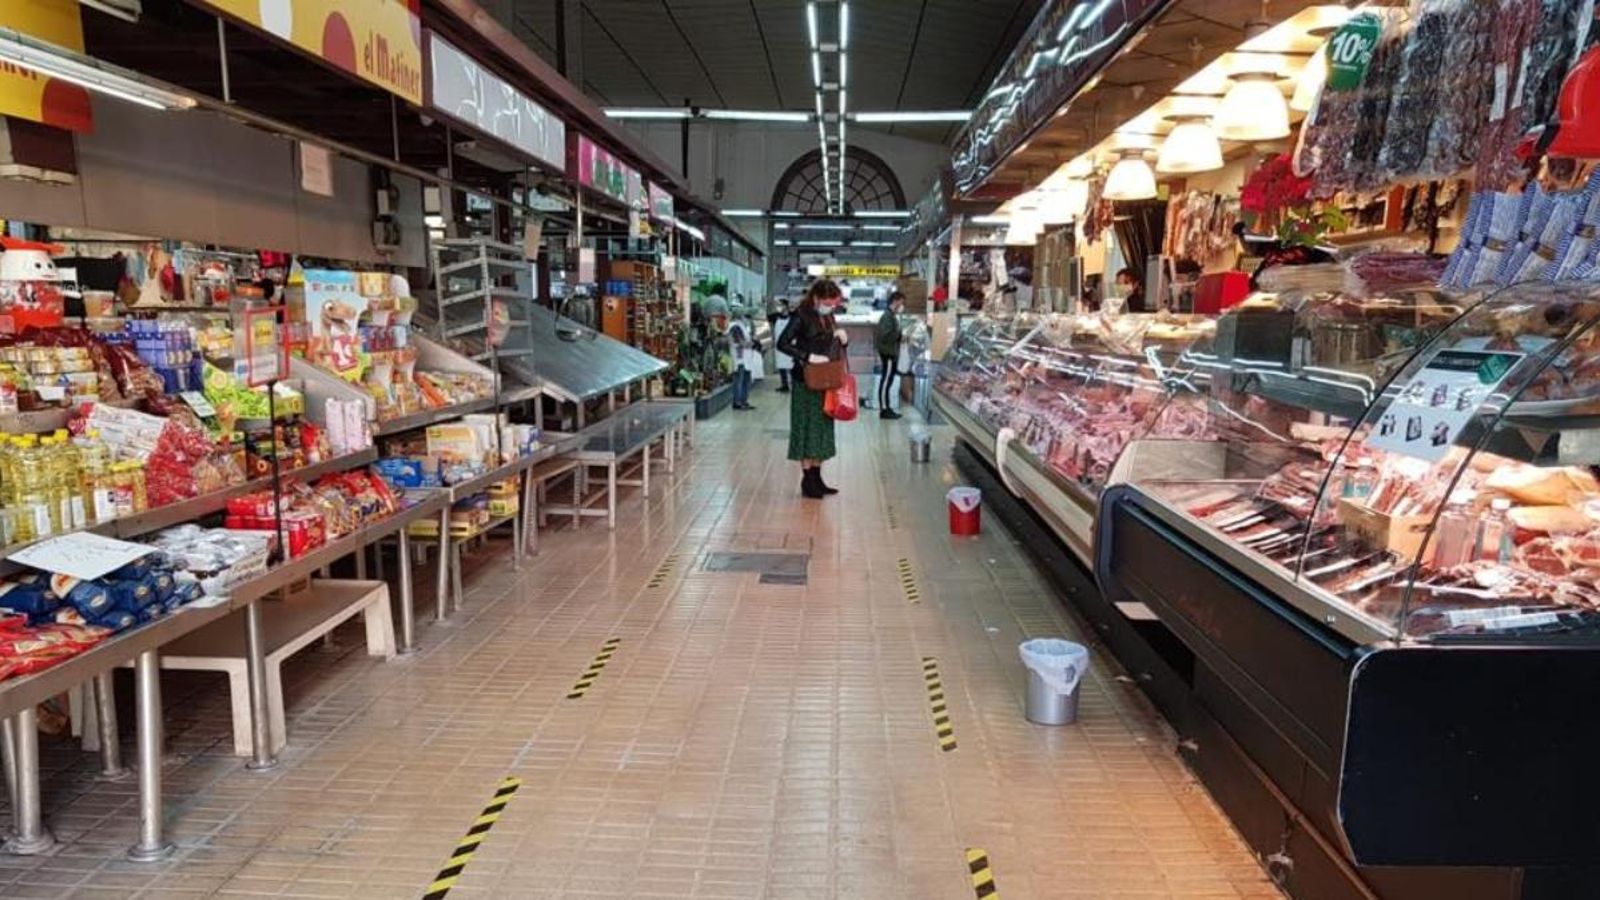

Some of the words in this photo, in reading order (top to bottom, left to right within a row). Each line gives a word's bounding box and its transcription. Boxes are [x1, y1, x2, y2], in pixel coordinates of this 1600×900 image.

[364, 29, 374, 75] el
[375, 32, 420, 98] Matiner
[1332, 31, 1373, 64] 10%
